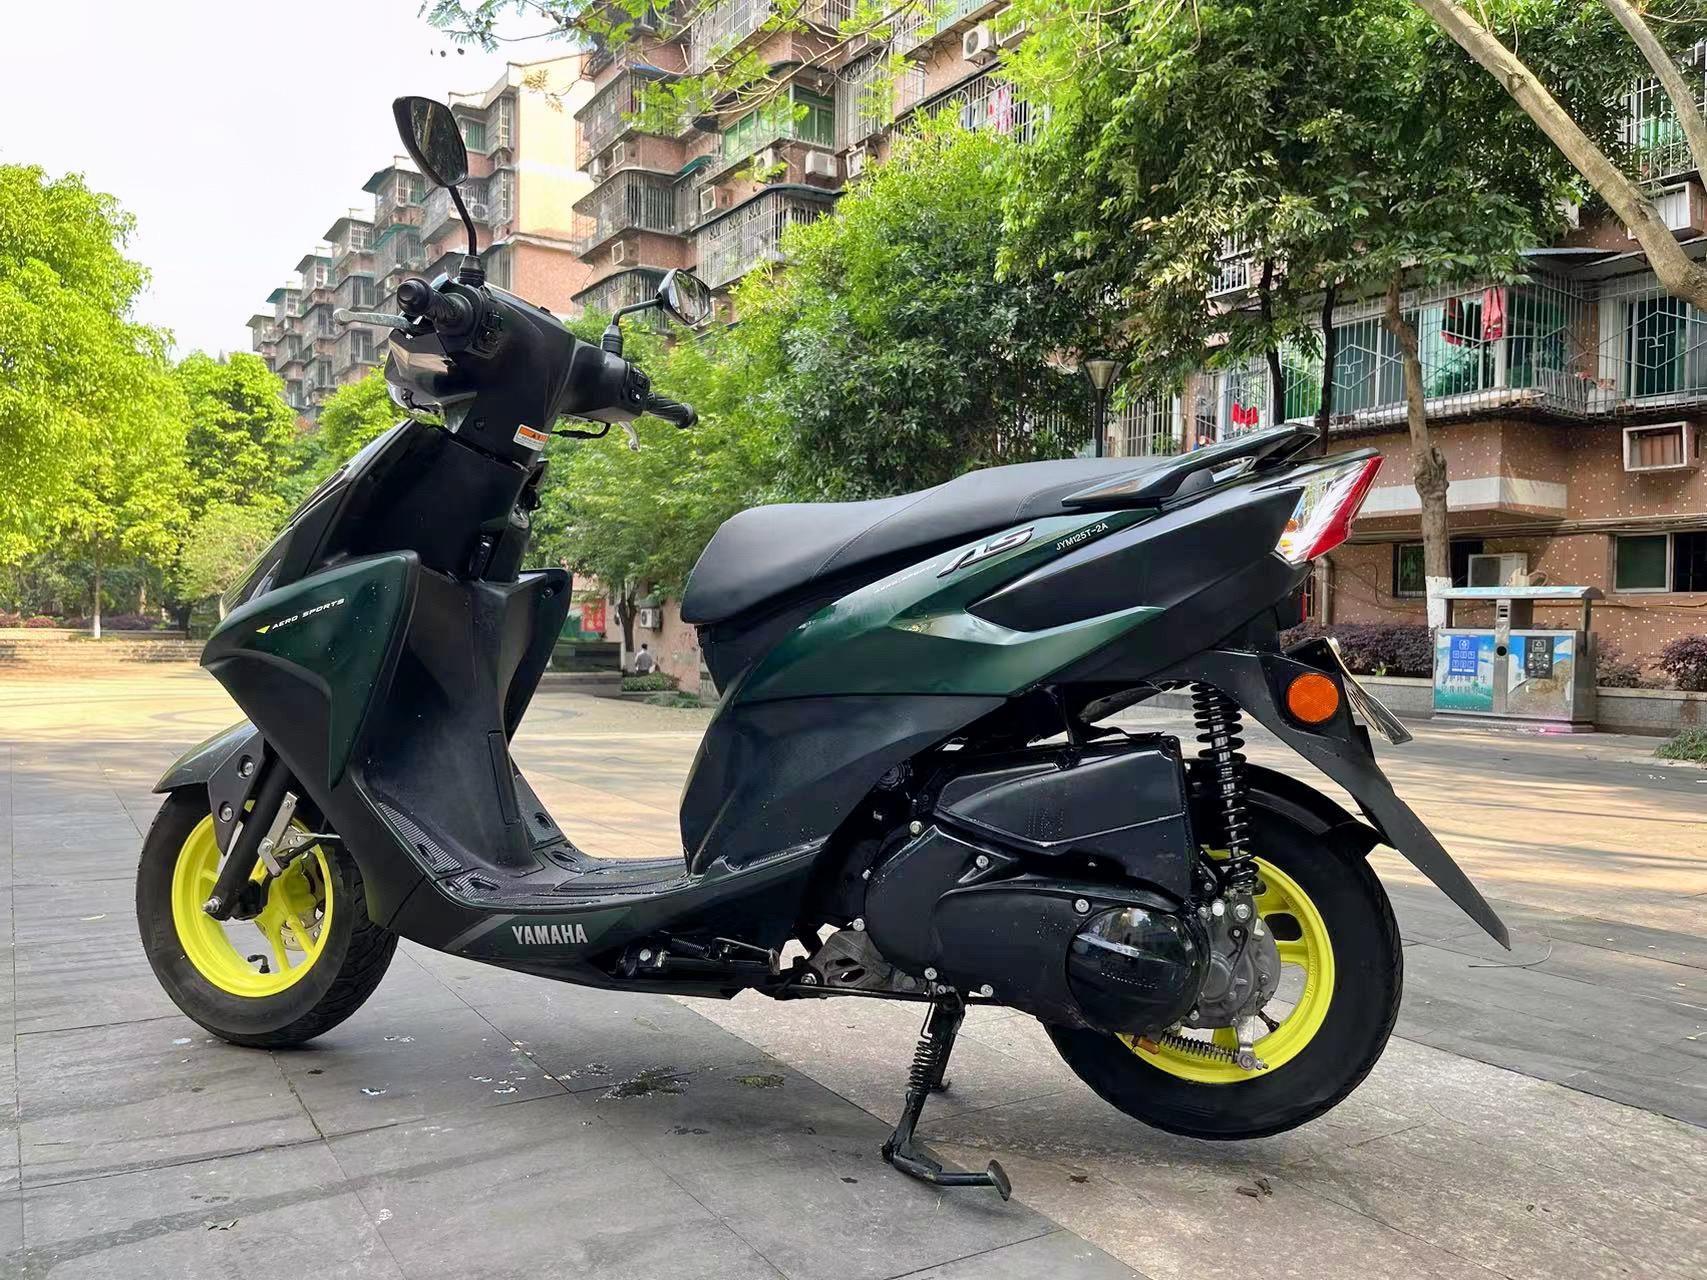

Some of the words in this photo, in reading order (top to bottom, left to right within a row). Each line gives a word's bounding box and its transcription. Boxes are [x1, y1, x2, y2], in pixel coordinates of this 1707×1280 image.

[1055, 522, 1109, 551] JYM125T-2A
[271, 615, 299, 630] AERO
[302, 598, 345, 618] SPORTS
[511, 923, 589, 945] YAMAHA
